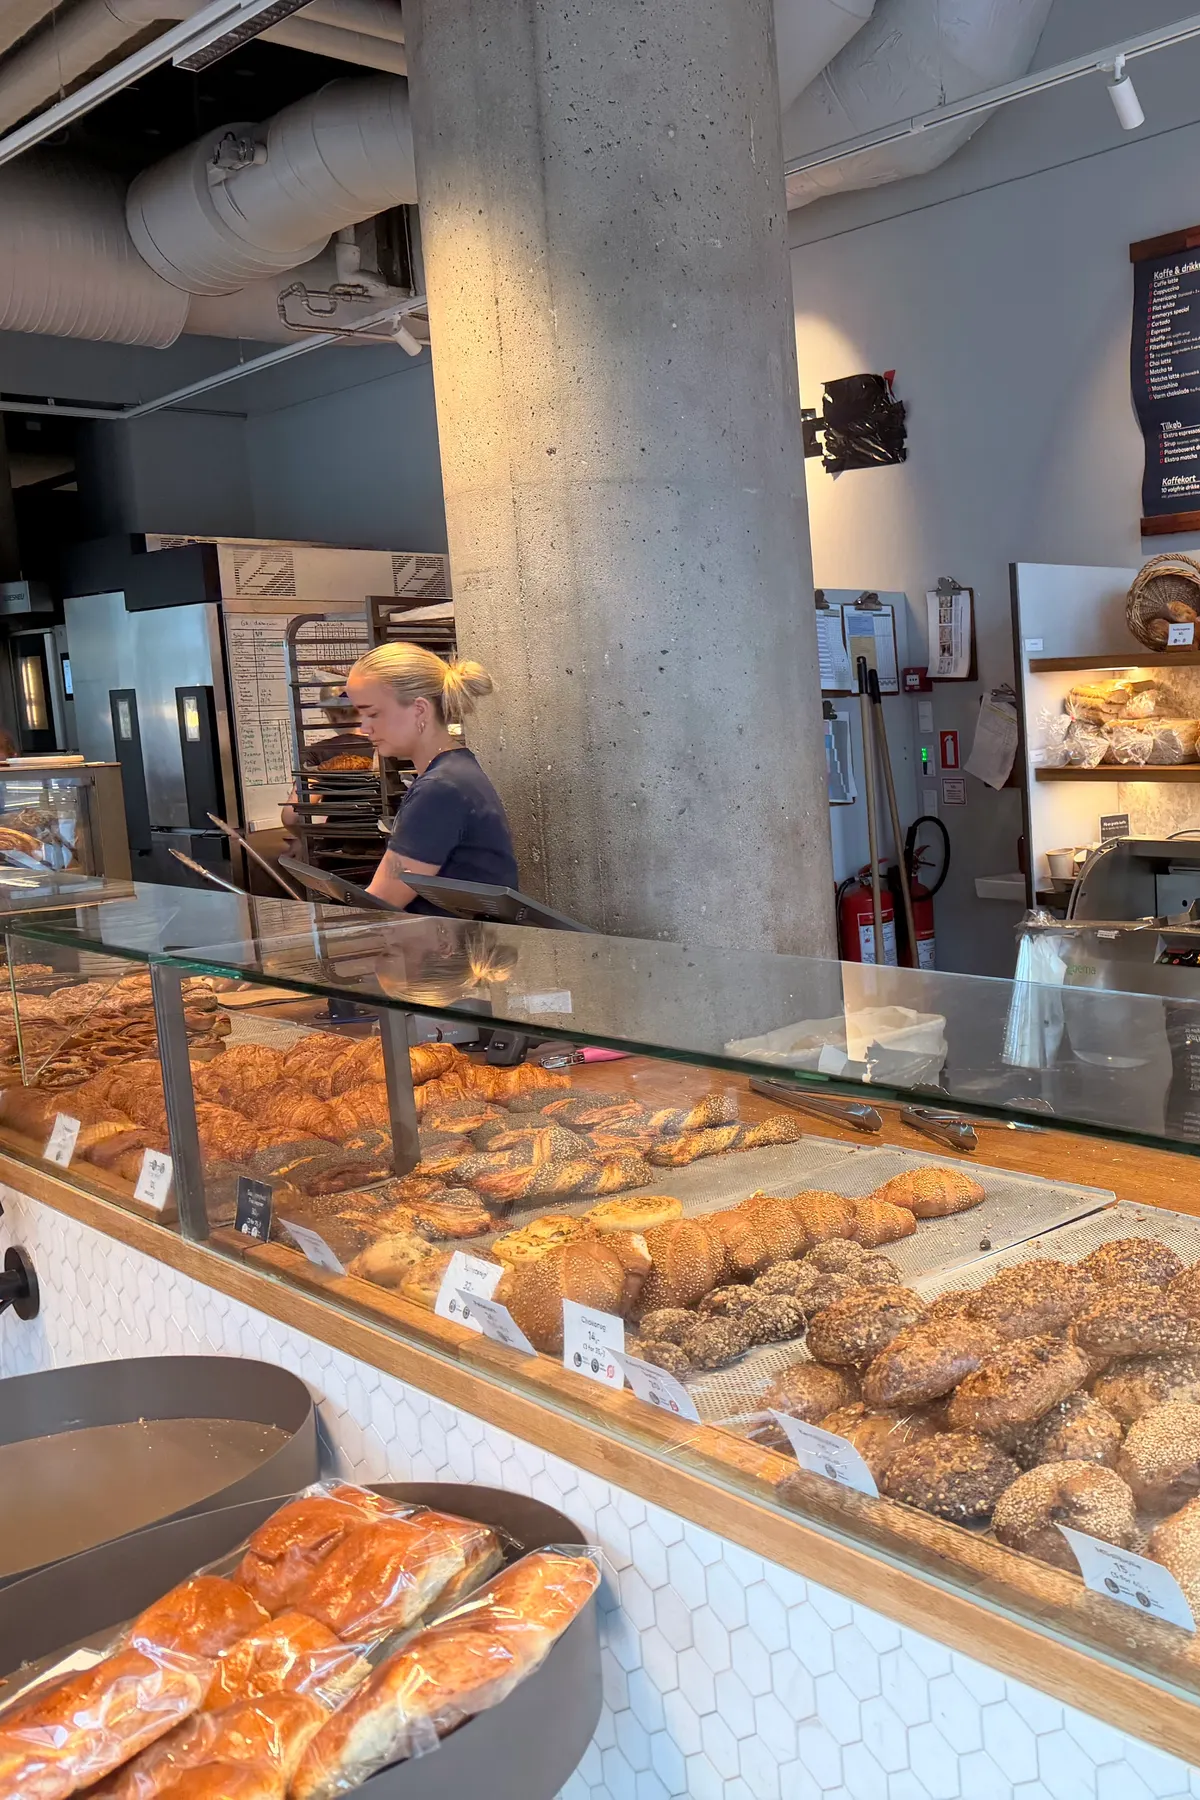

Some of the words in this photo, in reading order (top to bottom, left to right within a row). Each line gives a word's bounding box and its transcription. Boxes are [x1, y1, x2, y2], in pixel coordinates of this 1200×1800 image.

[1153, 268, 1174, 280] Kaffe
[1174, 265, 1180, 275] &
[1153, 285, 1180, 296] Cappuccino
[1152, 294, 1177, 304] Americano
[1151, 319, 1171, 328] Cortado
[1161, 420, 1182, 432] Tilkøb
[1162, 474, 1197, 487] Kaffekort
